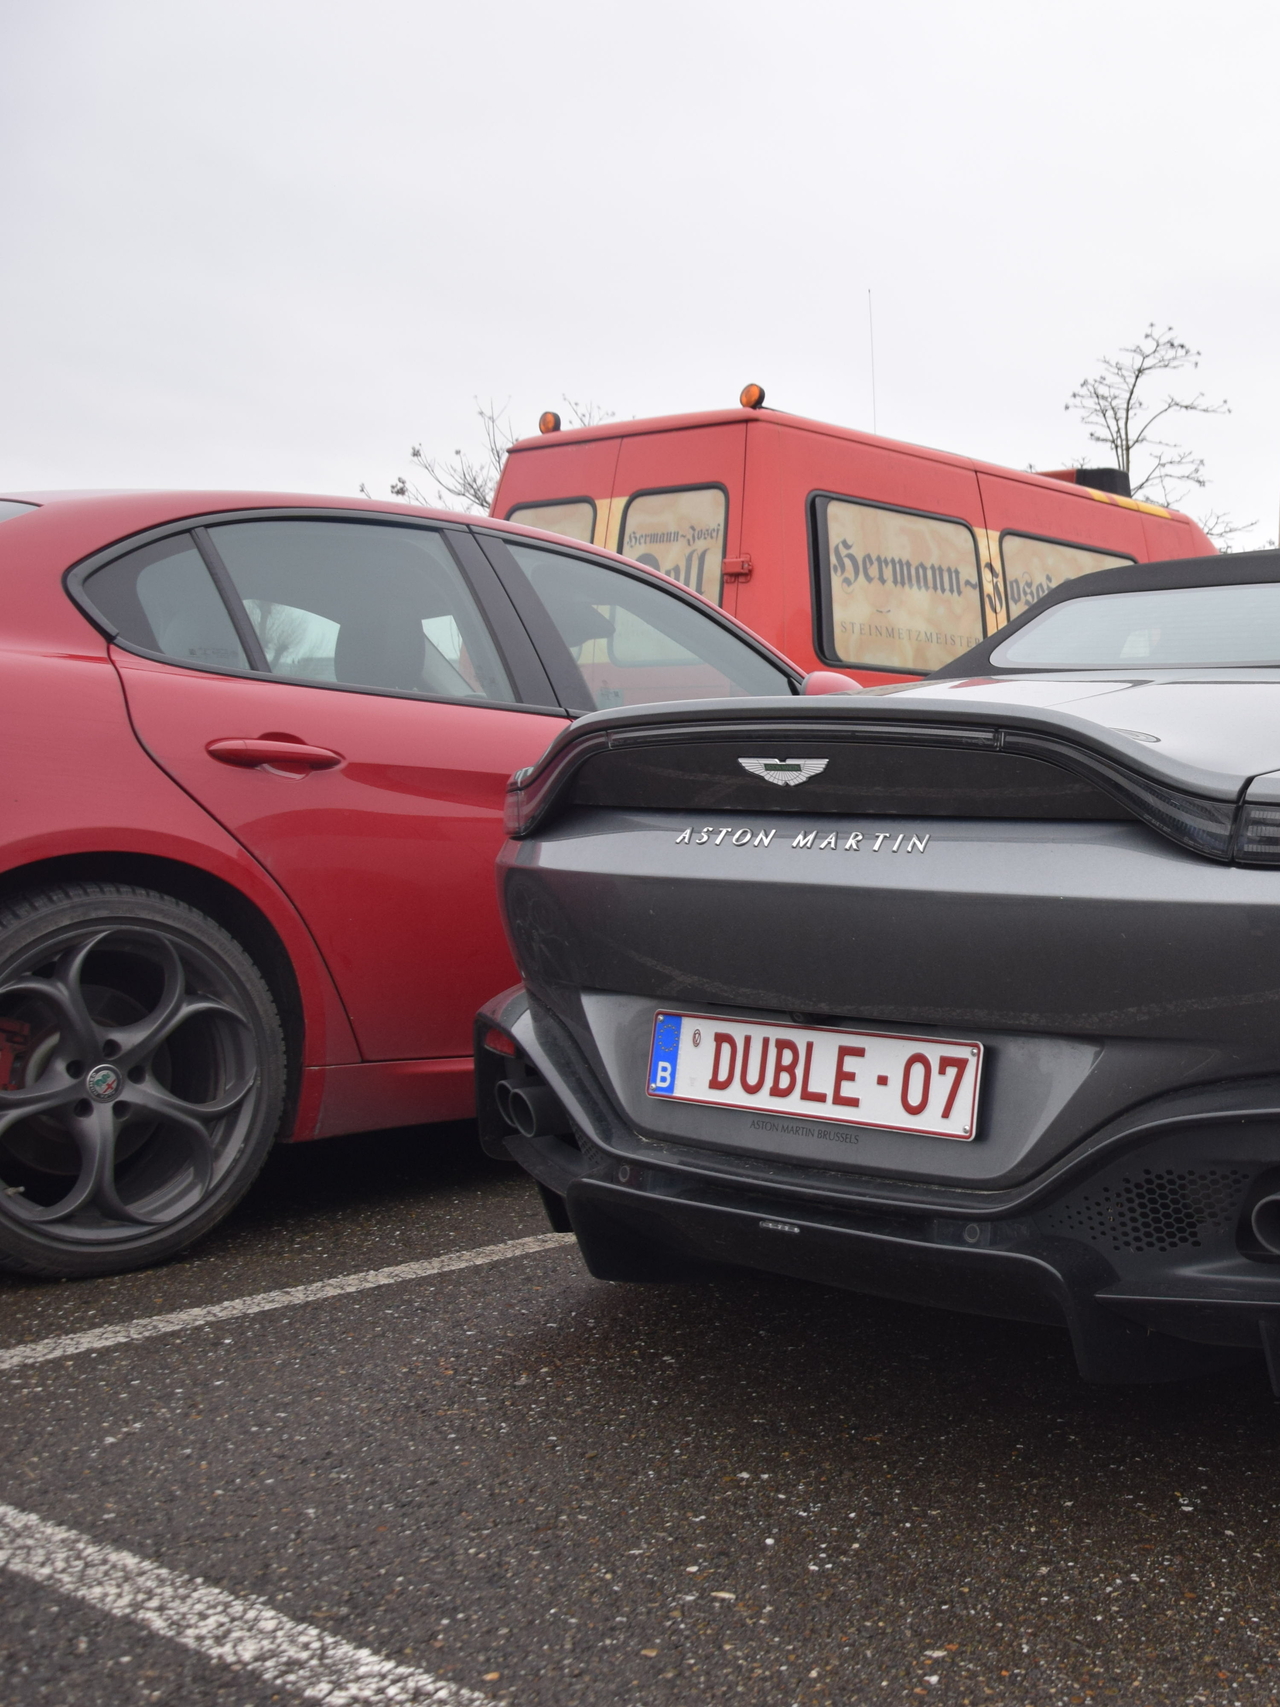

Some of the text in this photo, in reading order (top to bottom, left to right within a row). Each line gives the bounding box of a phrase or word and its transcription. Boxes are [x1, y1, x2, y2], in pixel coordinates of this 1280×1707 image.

[675, 826, 931, 853] ASTON MARTIN
[656, 1031, 970, 1119] B DUBLE-07
[750, 1120, 859, 1145] ASTON MARTIN BRUSSELS
